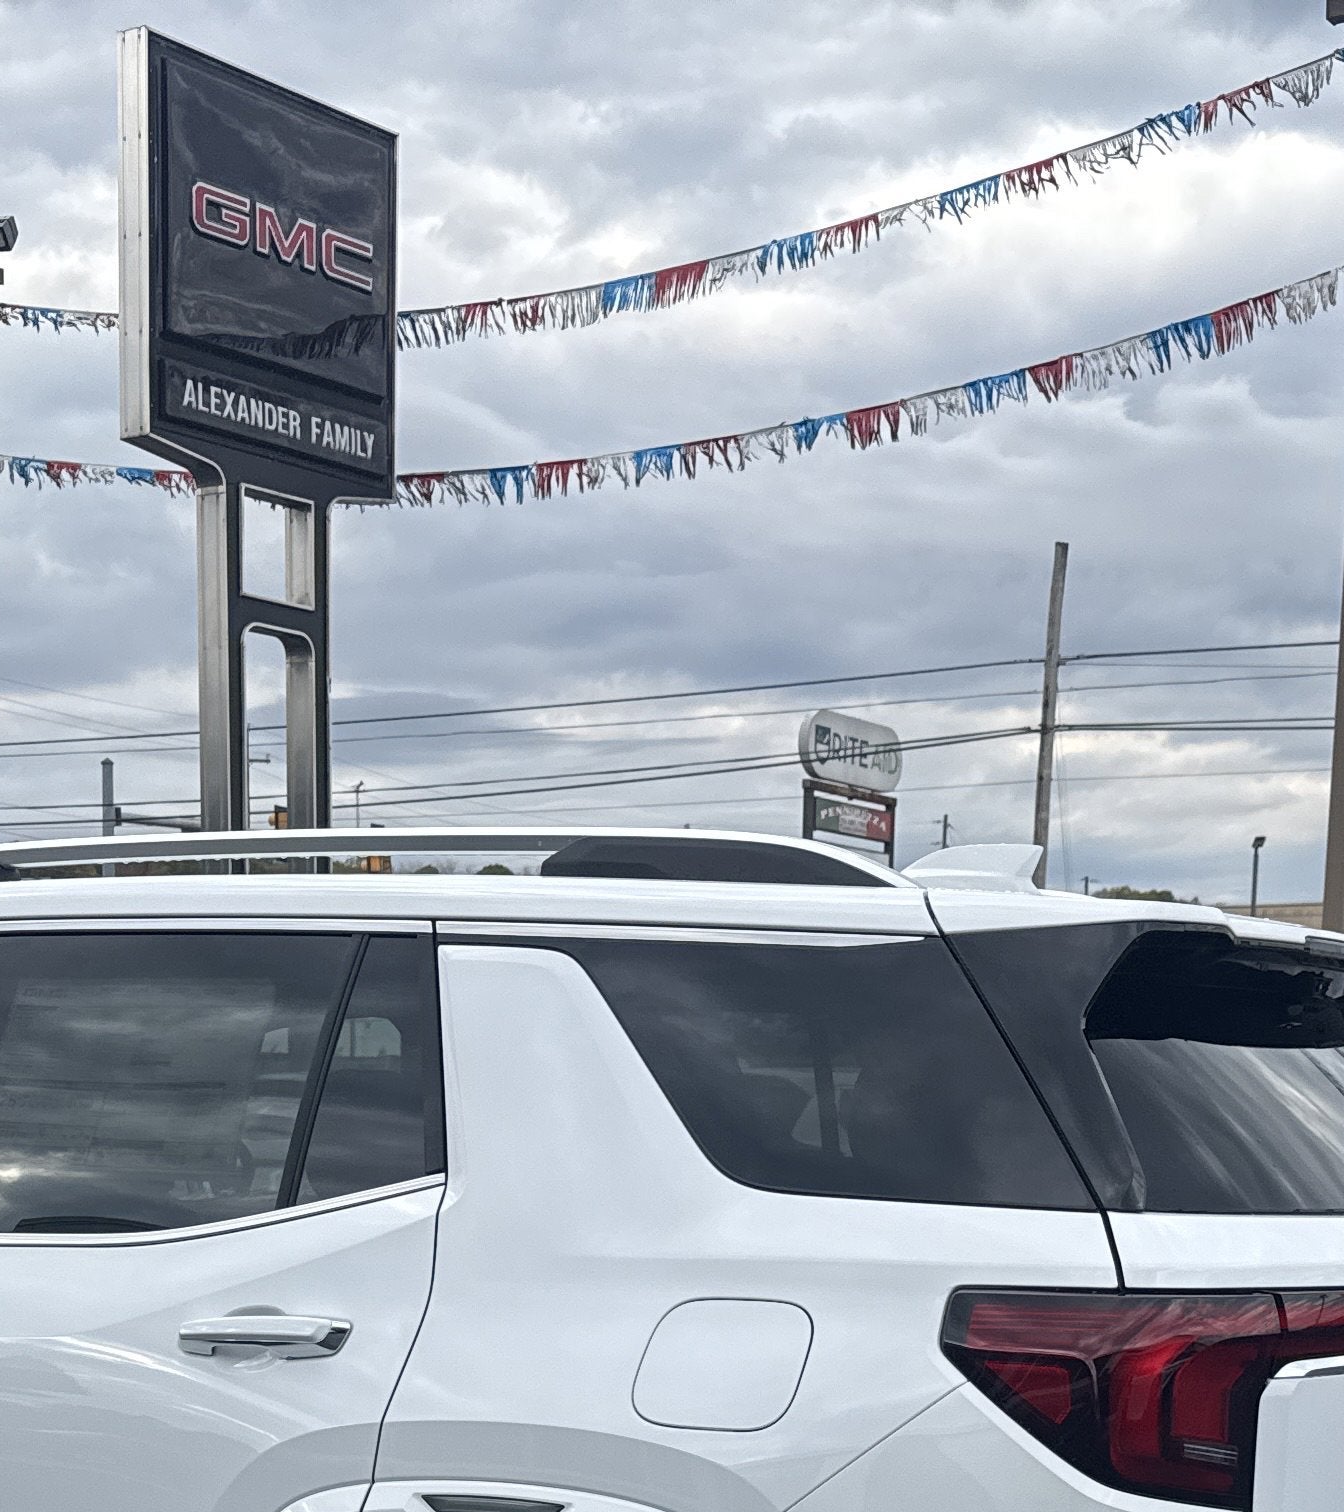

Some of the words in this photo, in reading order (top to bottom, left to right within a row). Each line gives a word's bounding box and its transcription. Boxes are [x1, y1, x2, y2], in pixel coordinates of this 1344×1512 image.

[192, 181, 374, 293] GMC
[182, 378, 302, 440] ALEXANDER
[311, 416, 375, 460] FAMILY
[832, 732, 869, 768] RITE
[871, 742, 898, 775] AID
